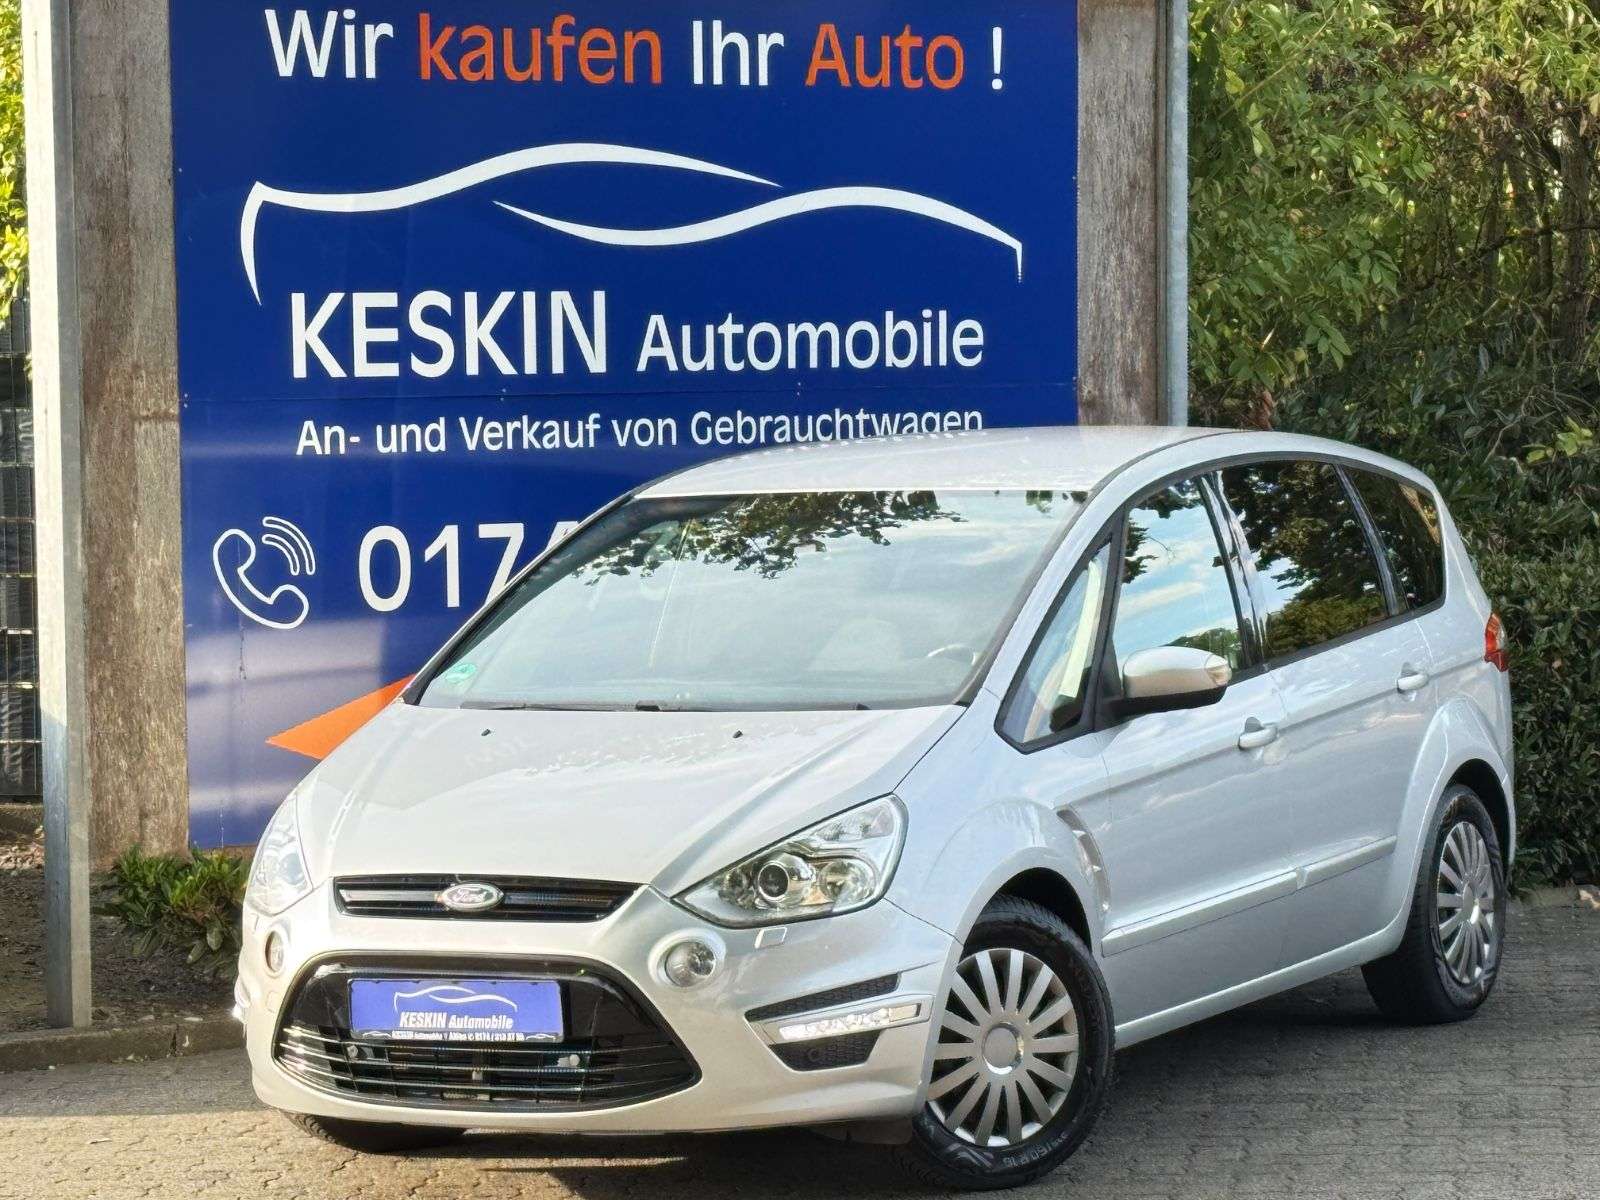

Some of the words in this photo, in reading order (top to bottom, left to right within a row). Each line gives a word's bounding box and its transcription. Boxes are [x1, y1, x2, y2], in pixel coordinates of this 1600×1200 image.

[264, 9, 394, 79] Wir
[419, 13, 662, 84] kaufen
[692, 20, 785, 86] Ihr
[805, 23, 965, 90] Auto
[991, 26, 1004, 90] !
[291, 290, 607, 379] KESKIN
[636, 308, 984, 372] Automobile
[295, 420, 361, 456] An-
[375, 416, 446, 454] und
[458, 412, 601, 451] Verkauf
[611, 417, 677, 447] von
[399, 1011, 448, 1028] KESKIN
[448, 1014, 514, 1029] Automobile
